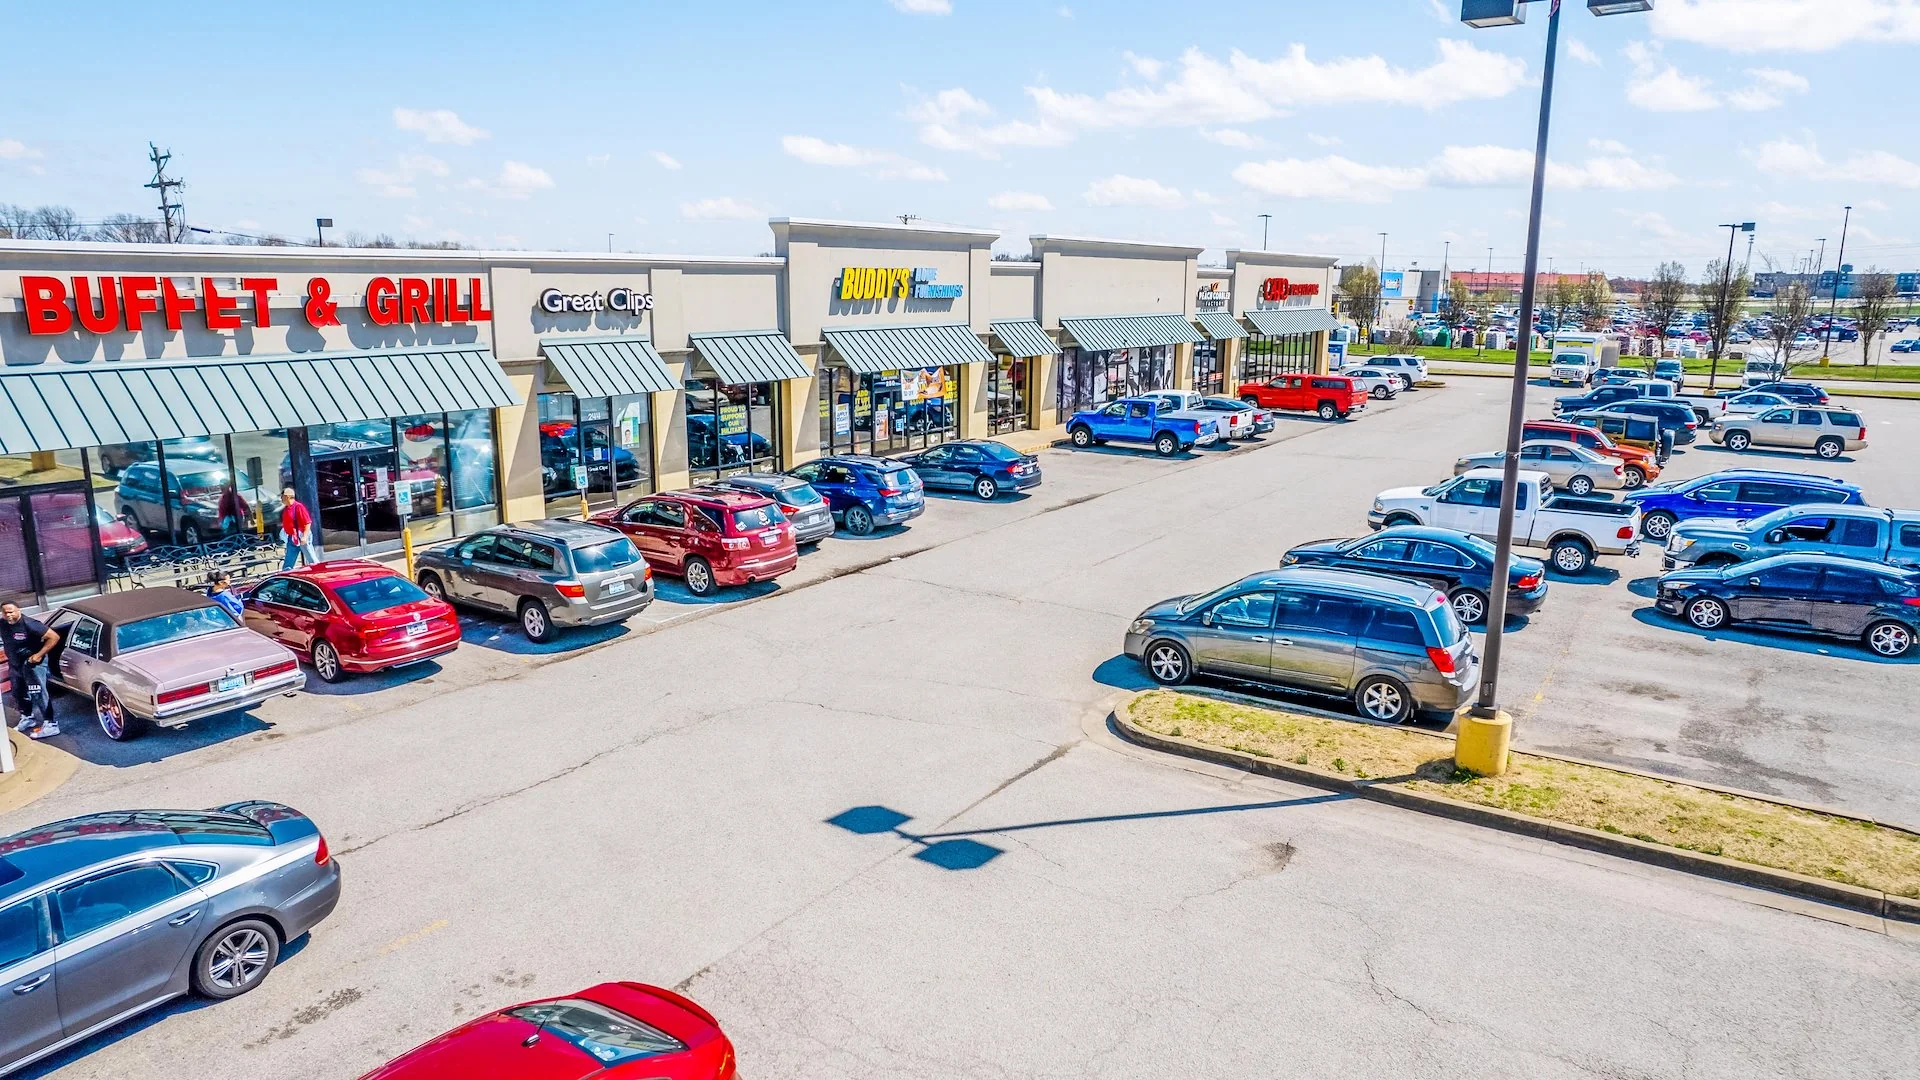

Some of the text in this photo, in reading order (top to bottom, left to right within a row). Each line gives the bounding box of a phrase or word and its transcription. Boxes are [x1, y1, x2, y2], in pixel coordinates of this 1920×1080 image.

[841, 267, 910, 300] BUDDY'S
[914, 267, 938, 281] HOME
[541, 288, 655, 316] Great Clips
[914, 284, 963, 299] FURNISHINGS
[19, 275, 492, 336] BUFFET & GRILL
[721, 412, 745, 421] SUPPORT
